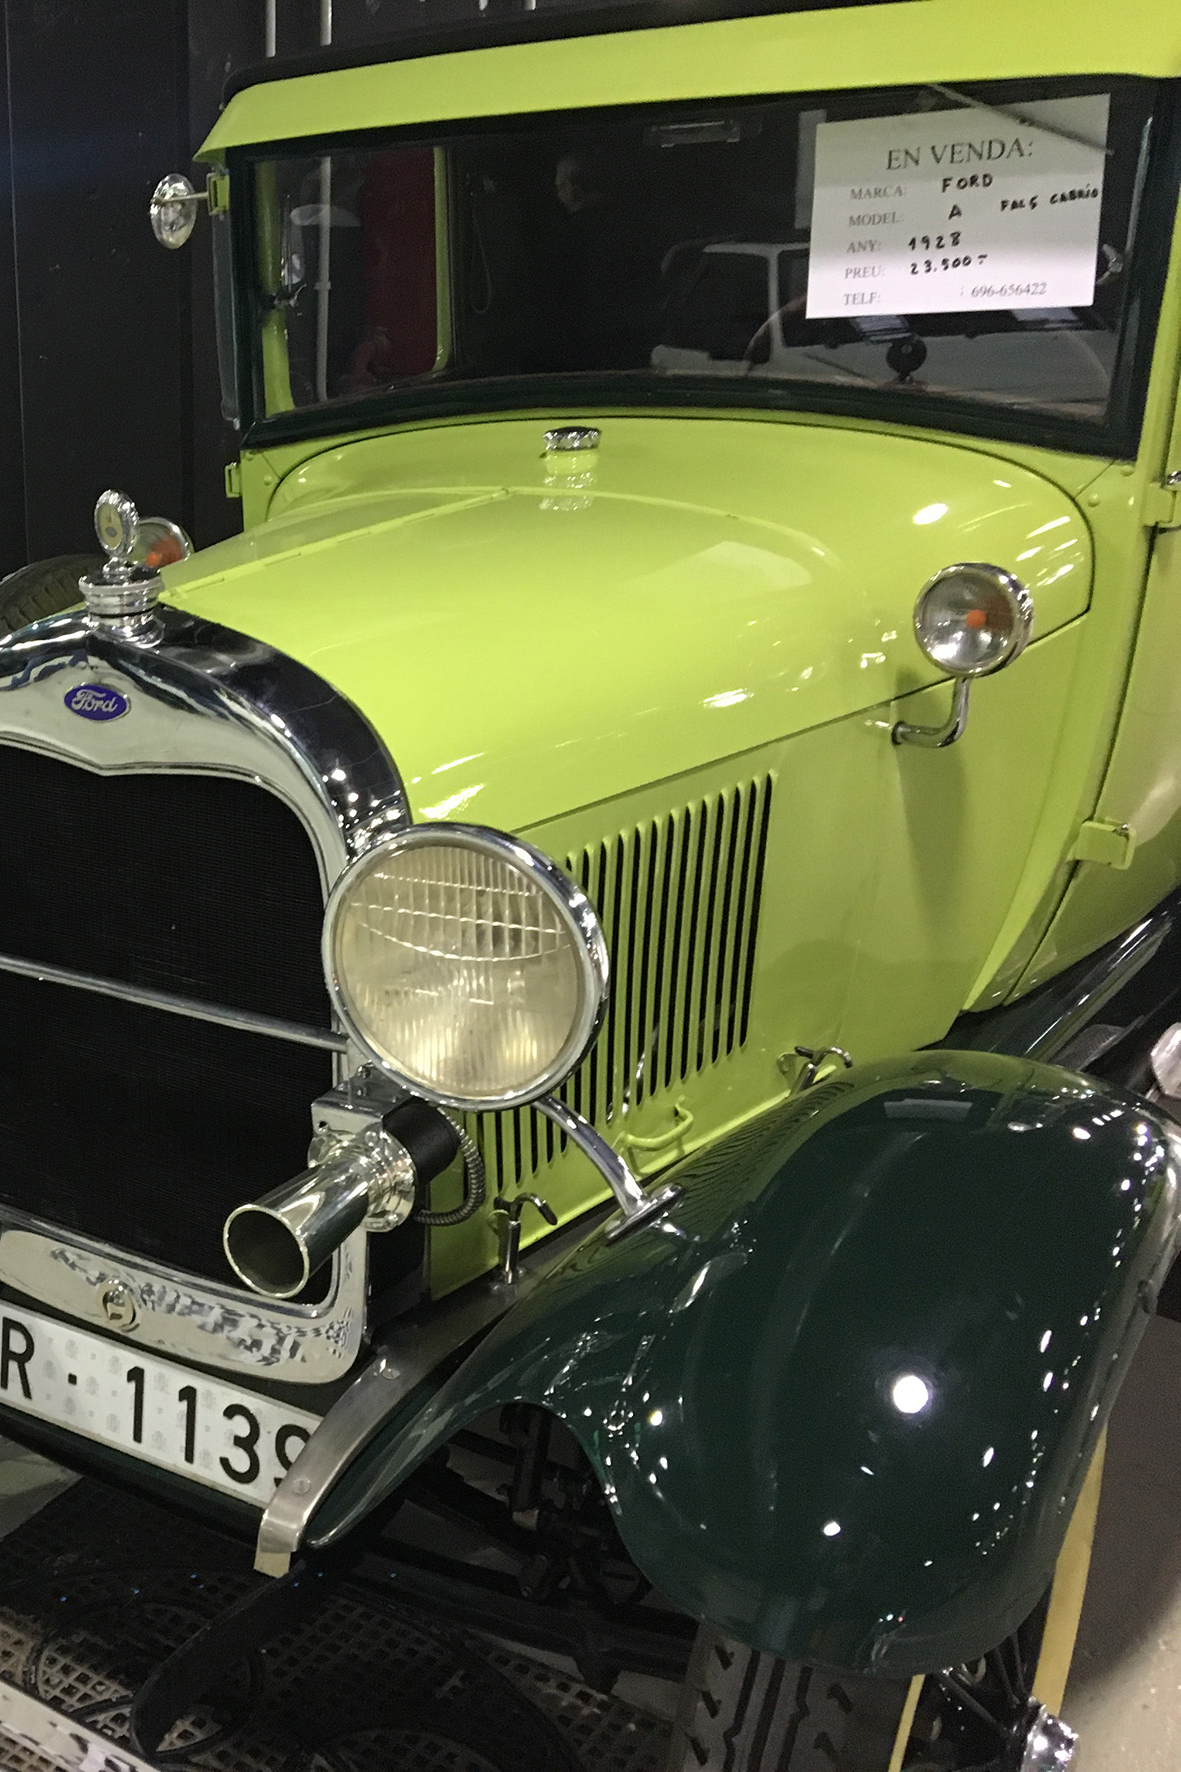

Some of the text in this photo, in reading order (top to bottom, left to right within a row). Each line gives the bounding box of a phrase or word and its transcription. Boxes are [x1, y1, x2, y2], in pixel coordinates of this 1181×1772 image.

[886, 138, 1033, 170] EN VENDA:
[941, 173, 993, 193] FORD
[948, 204, 962, 220] A
[907, 231, 962, 251] 1928
[71, 688, 120, 713] Ford
